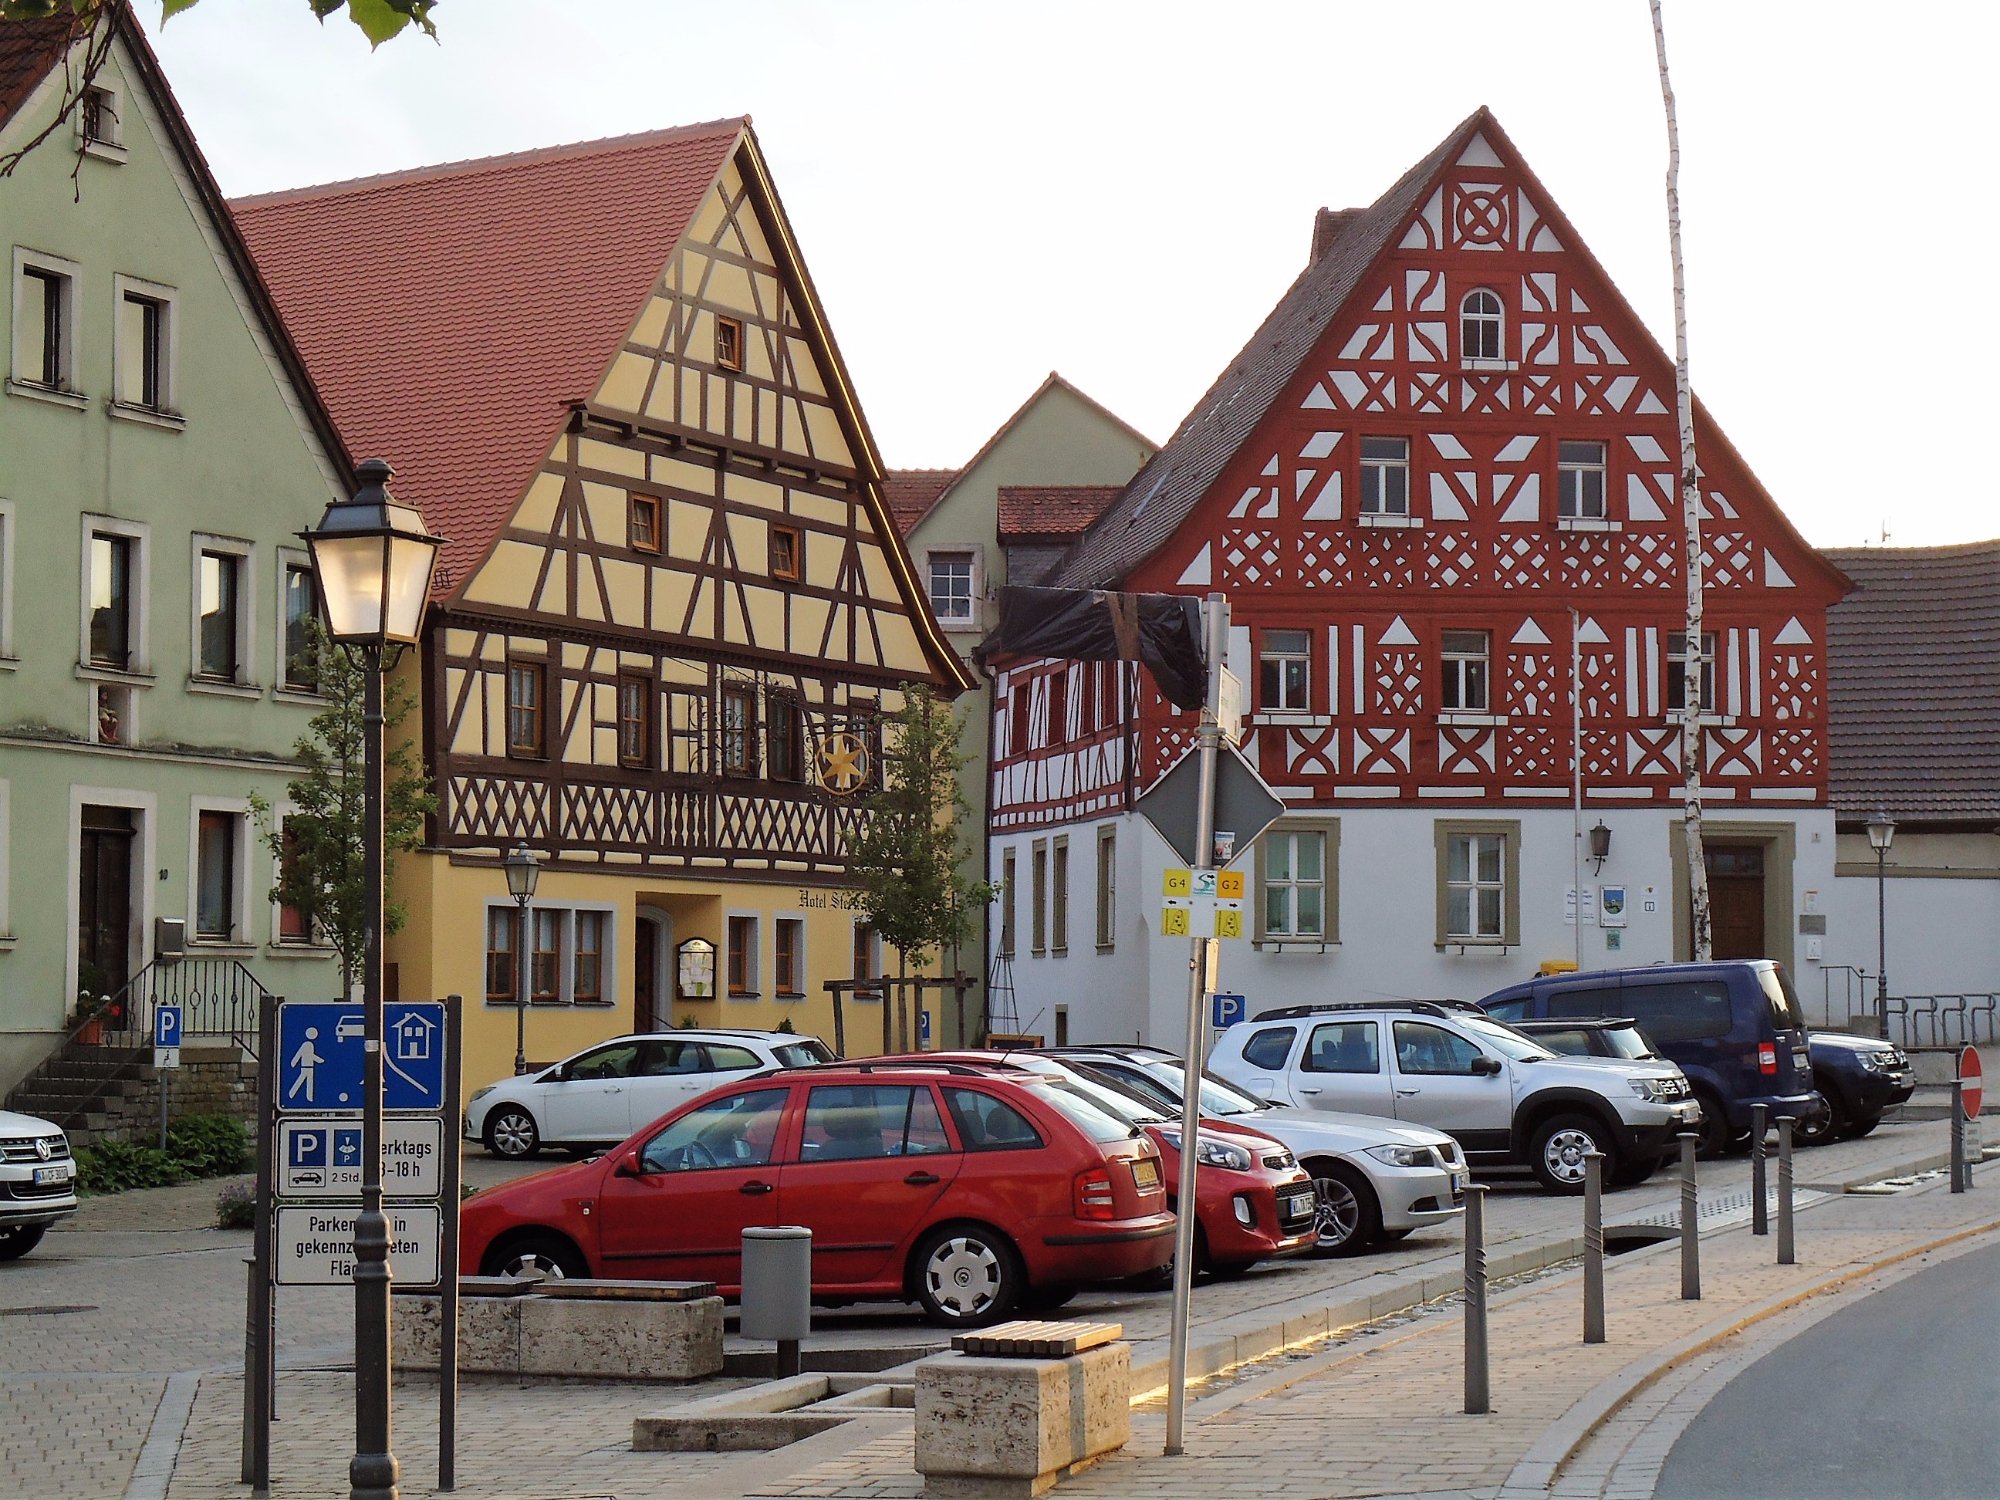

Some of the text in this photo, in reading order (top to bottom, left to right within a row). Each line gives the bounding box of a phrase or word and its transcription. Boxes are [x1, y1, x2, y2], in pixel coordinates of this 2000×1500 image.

[1168, 878, 1186, 888] G 4
[1221, 880, 1239, 890] G 2
[798, 889, 827, 909] Hotel
[1220, 998, 1238, 1024] P
[161, 1011, 175, 1041] P
[297, 1134, 318, 1163] P
[382, 1139, 432, 1159] erktags
[343, 1154, 351, 1163] P
[412, 1160, 420, 1177] h
[331, 1172, 362, 1183] 2 Std.
[394, 1215, 406, 1232] in
